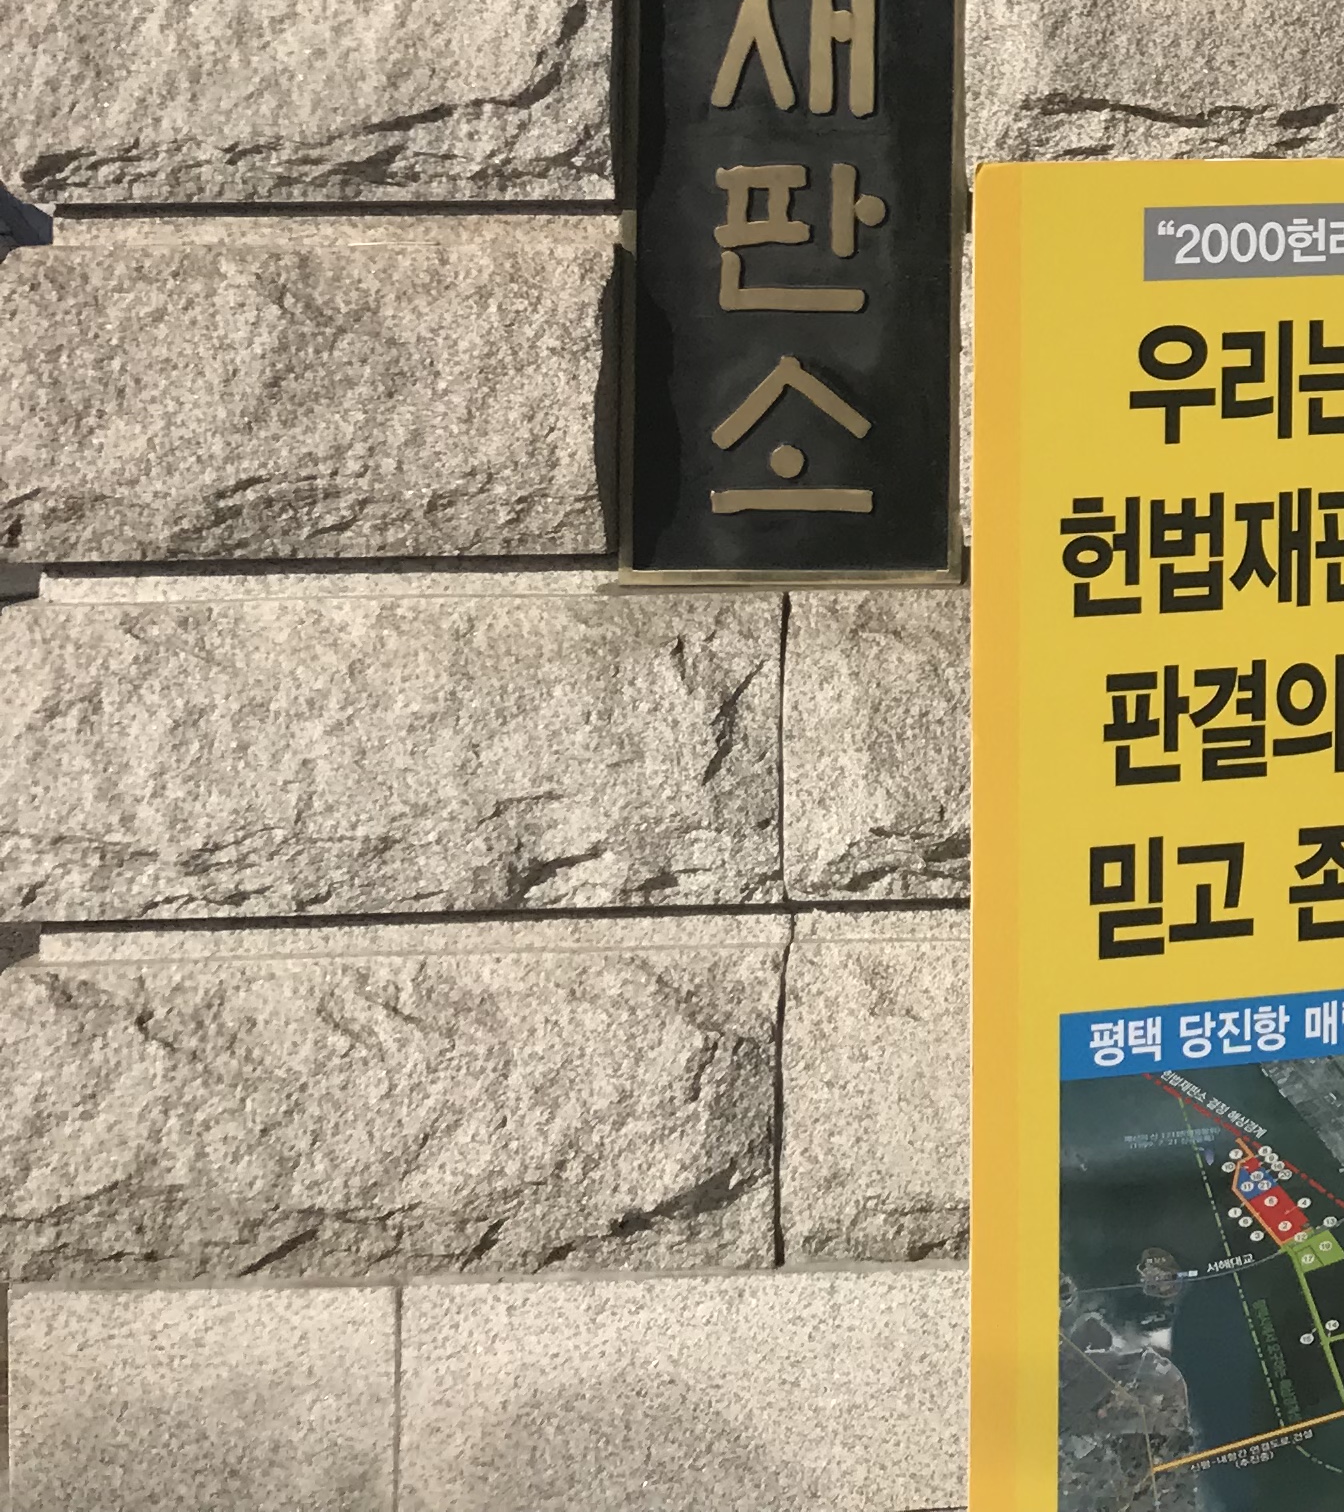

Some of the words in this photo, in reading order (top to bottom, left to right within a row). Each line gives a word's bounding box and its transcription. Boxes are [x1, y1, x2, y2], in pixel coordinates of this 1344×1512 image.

[1090, 836, 1253, 960] 믿고
[1090, 1017, 1161, 1066] 평택
[1180, 1005, 1290, 1058] 당진항
[1207, 1253, 1255, 1273] 서해대교
